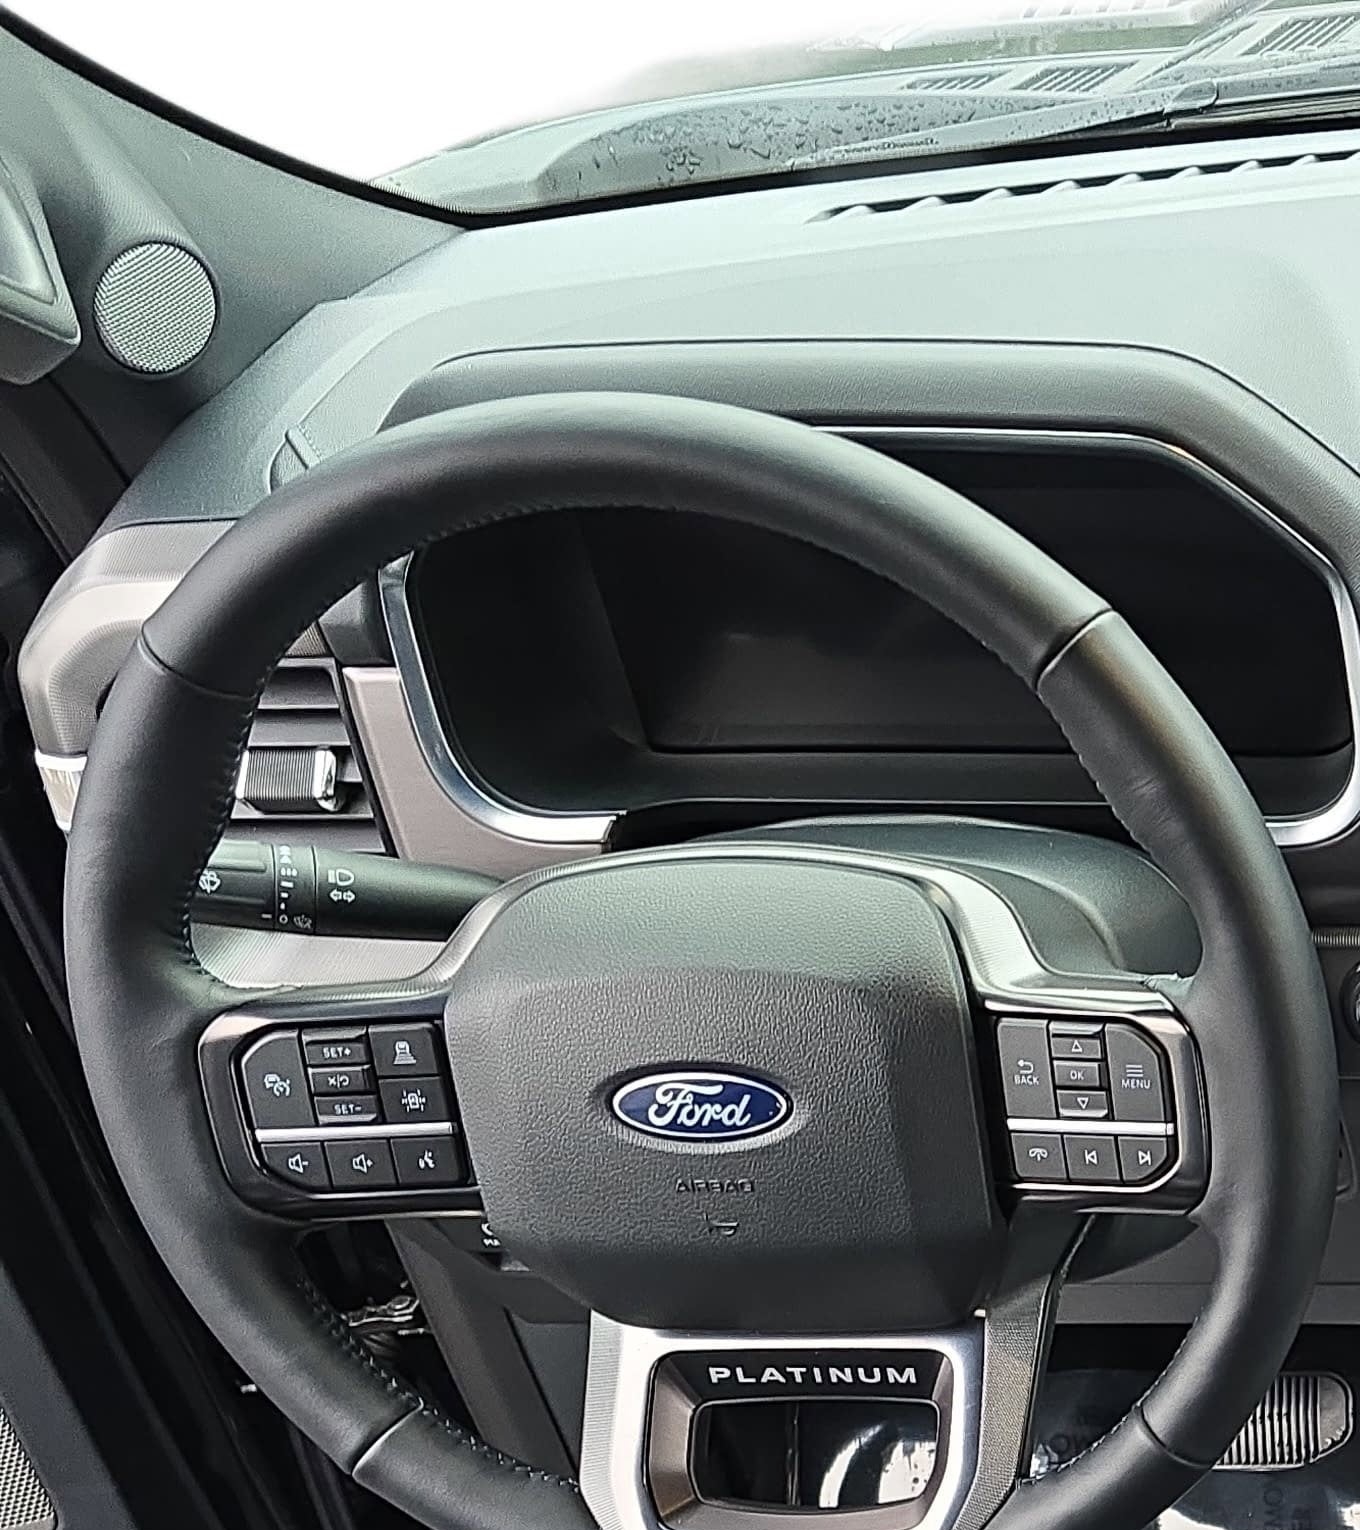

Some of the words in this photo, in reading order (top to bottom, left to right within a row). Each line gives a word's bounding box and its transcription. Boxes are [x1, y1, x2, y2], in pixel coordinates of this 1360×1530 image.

[1014, 1075, 1039, 1086] BACK
[1070, 1070, 1085, 1081] OK
[1121, 1079, 1150, 1090] MENU
[648, 1082, 751, 1127] Ford
[675, 1179, 755, 1193] AIRBAG
[708, 1366, 918, 1384] PLATINUM
